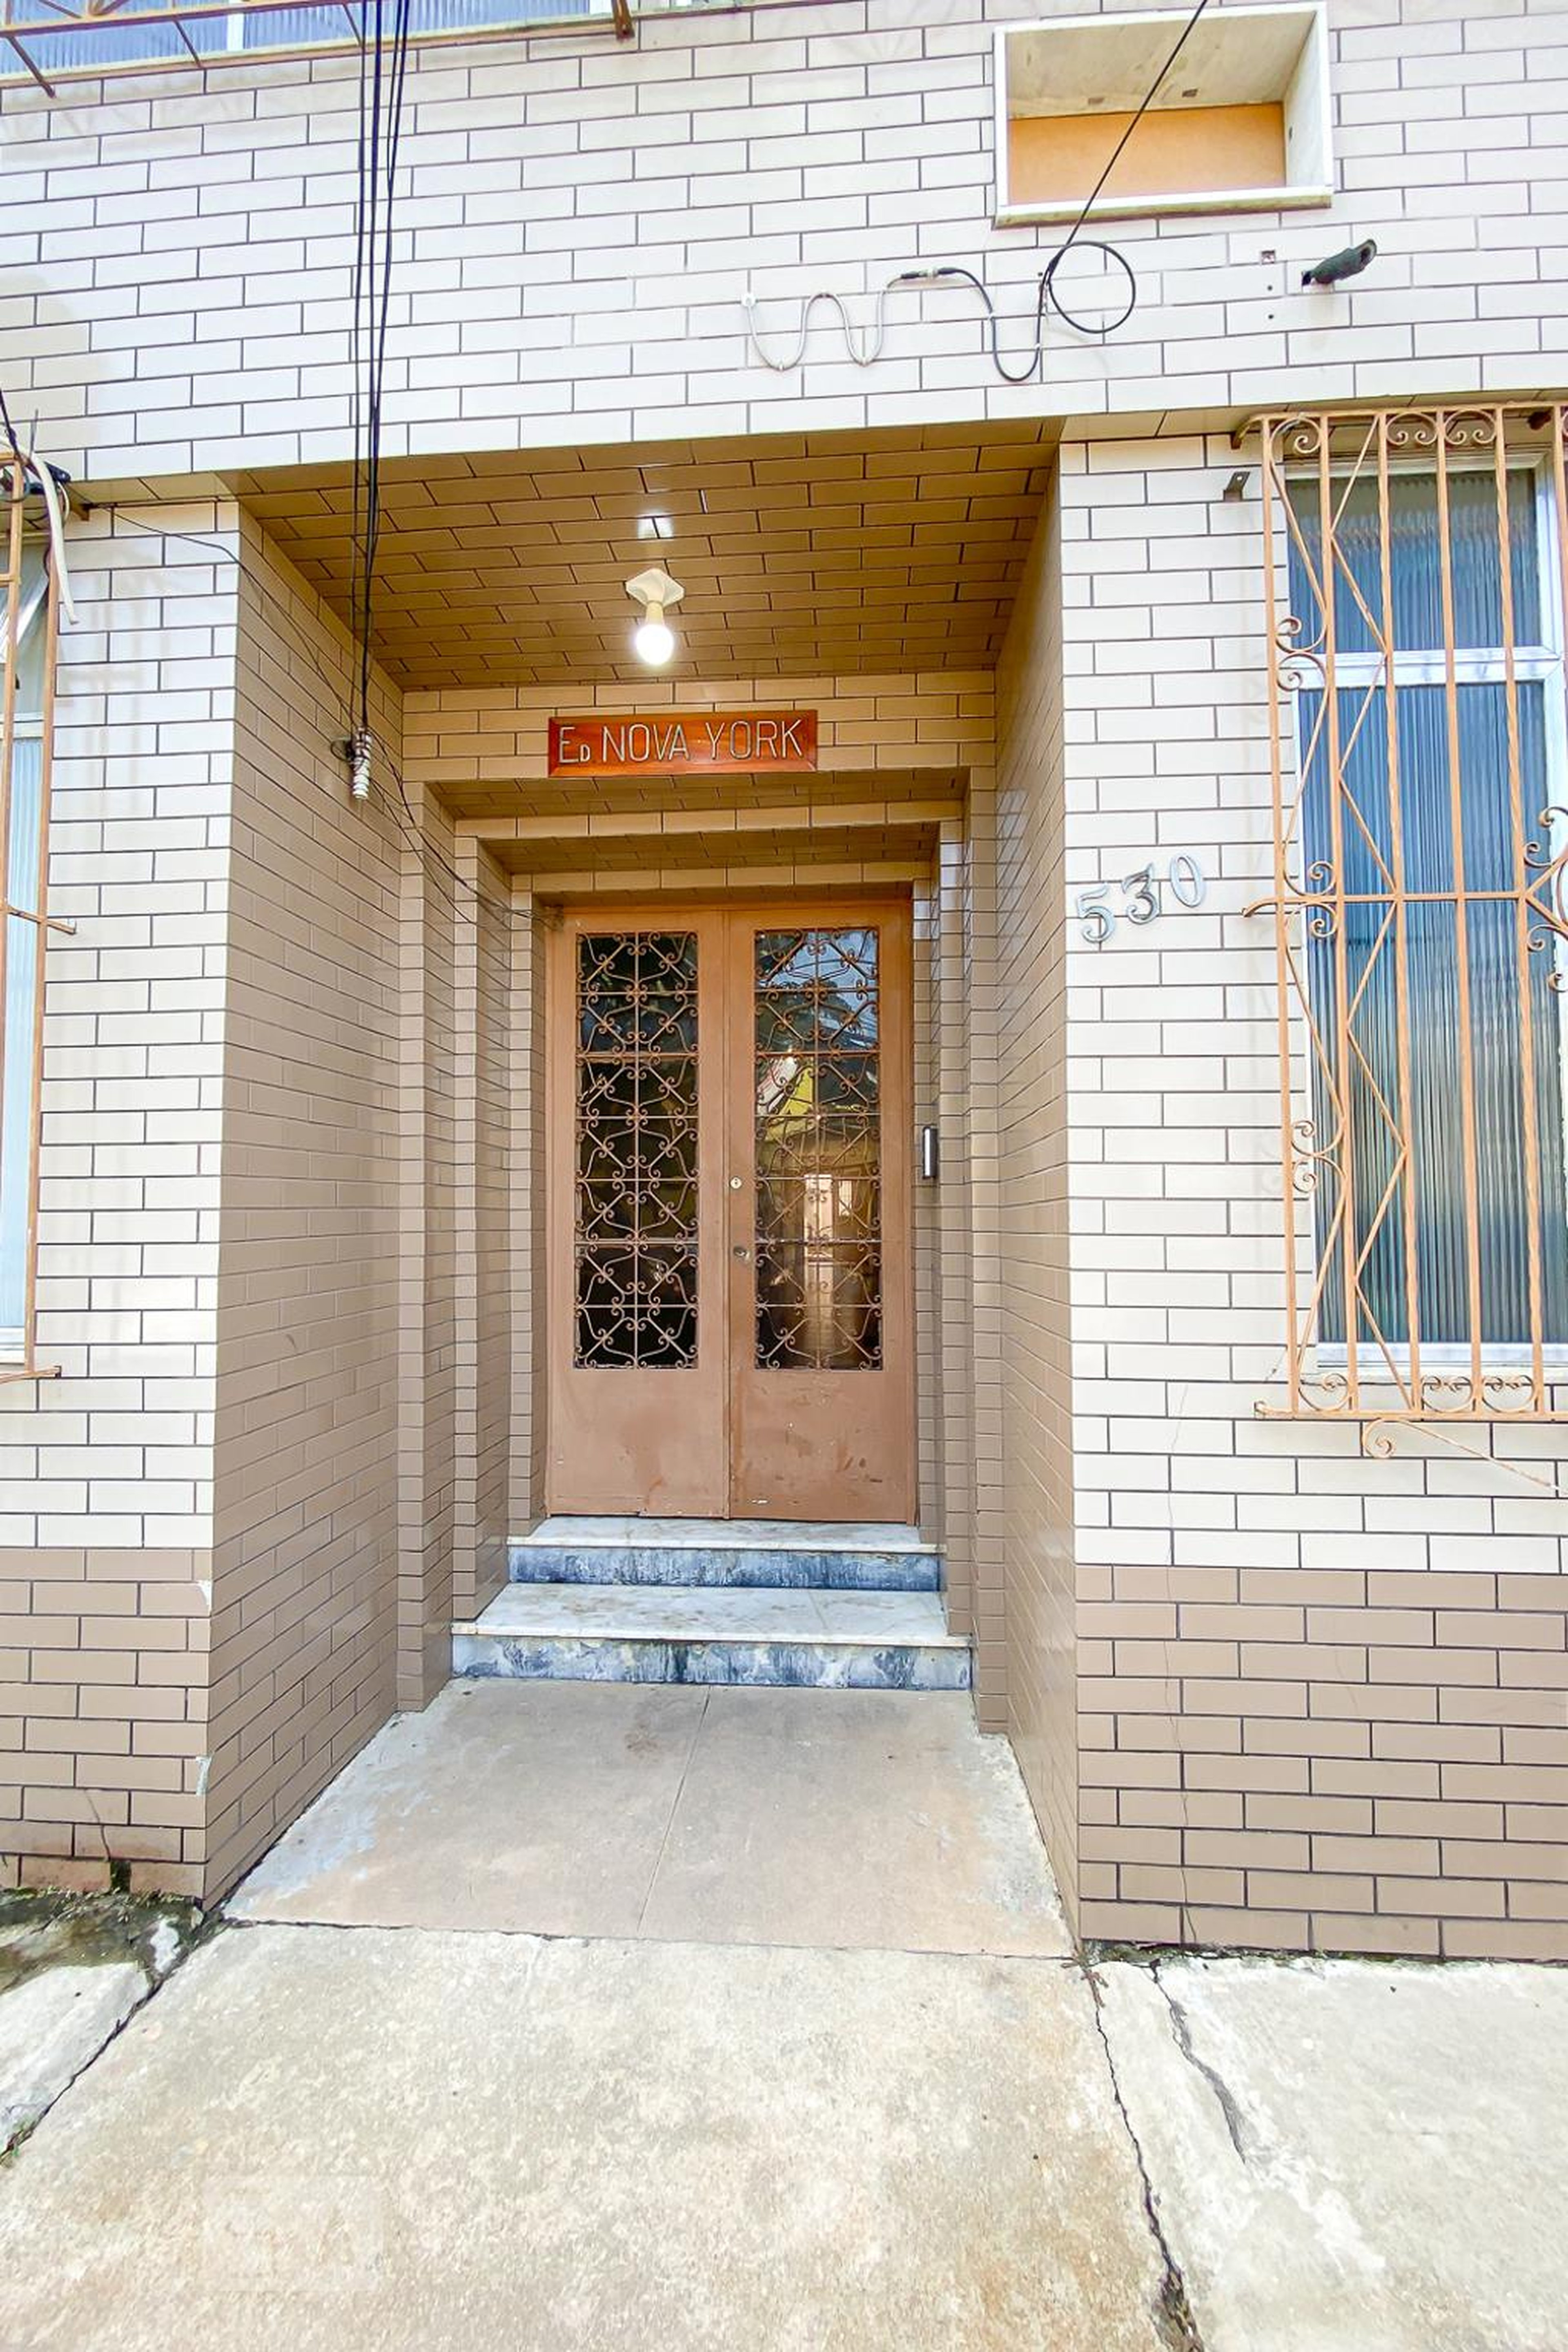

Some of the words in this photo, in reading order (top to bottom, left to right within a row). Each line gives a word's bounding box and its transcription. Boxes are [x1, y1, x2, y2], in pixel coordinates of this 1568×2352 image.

[602, 724, 690, 762] NOVA
[705, 719, 802, 759] YORK
[1077, 855, 1206, 943] 530
